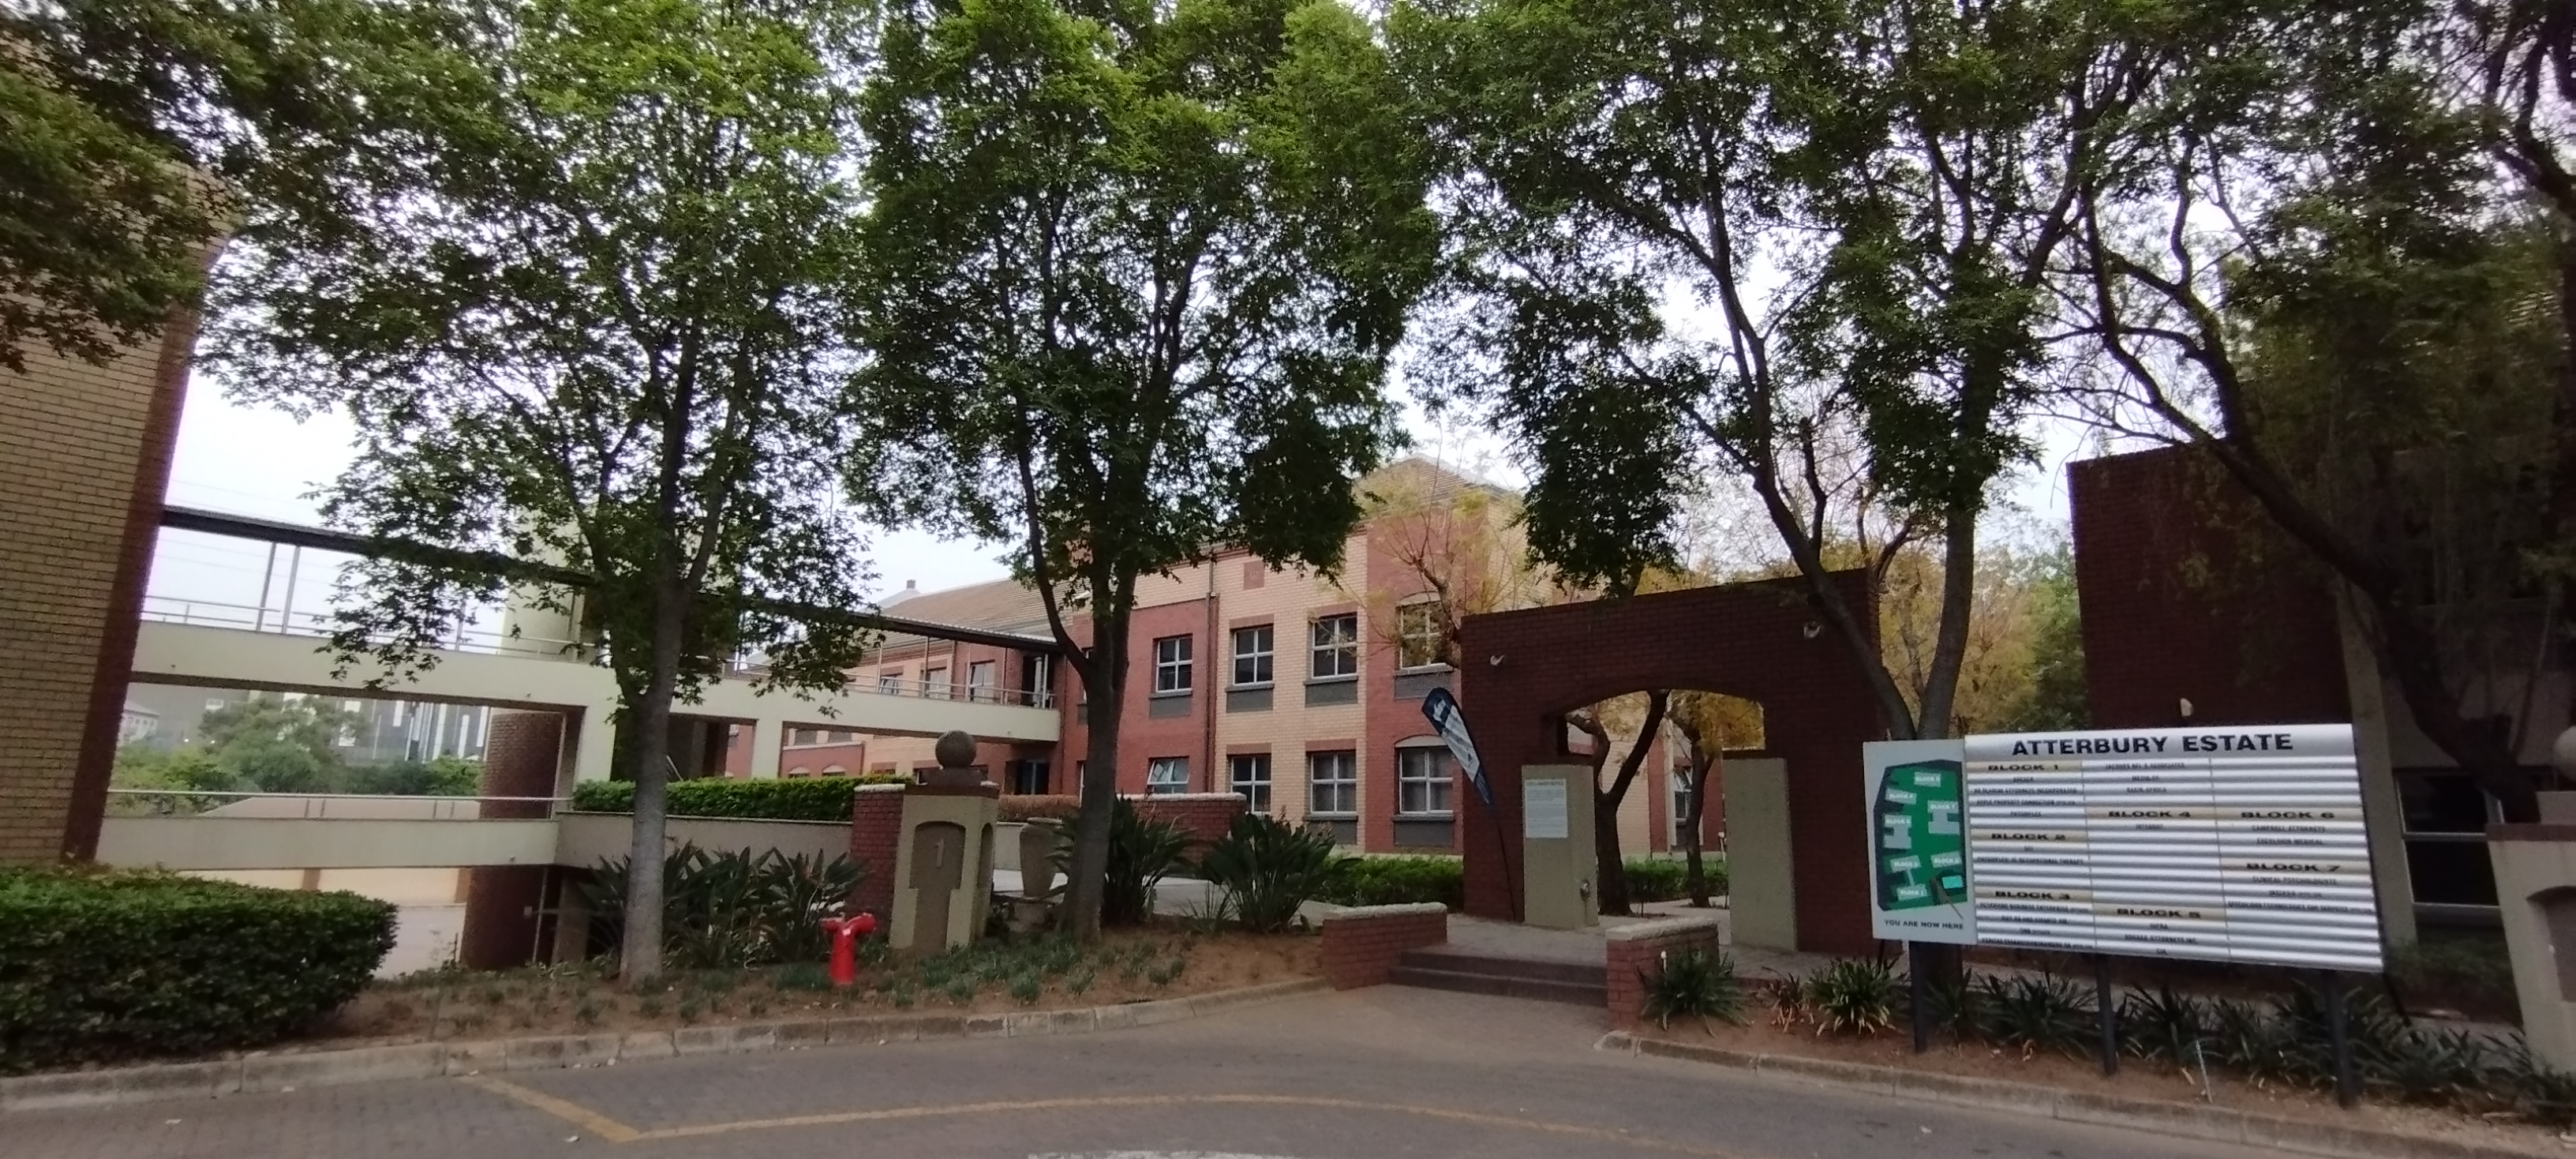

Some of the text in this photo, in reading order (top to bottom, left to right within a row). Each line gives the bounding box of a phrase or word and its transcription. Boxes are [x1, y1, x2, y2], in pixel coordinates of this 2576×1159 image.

[2012, 733, 2293, 756] ATTERBURY ESTATE
[2246, 863, 2319, 872] BLOCK
